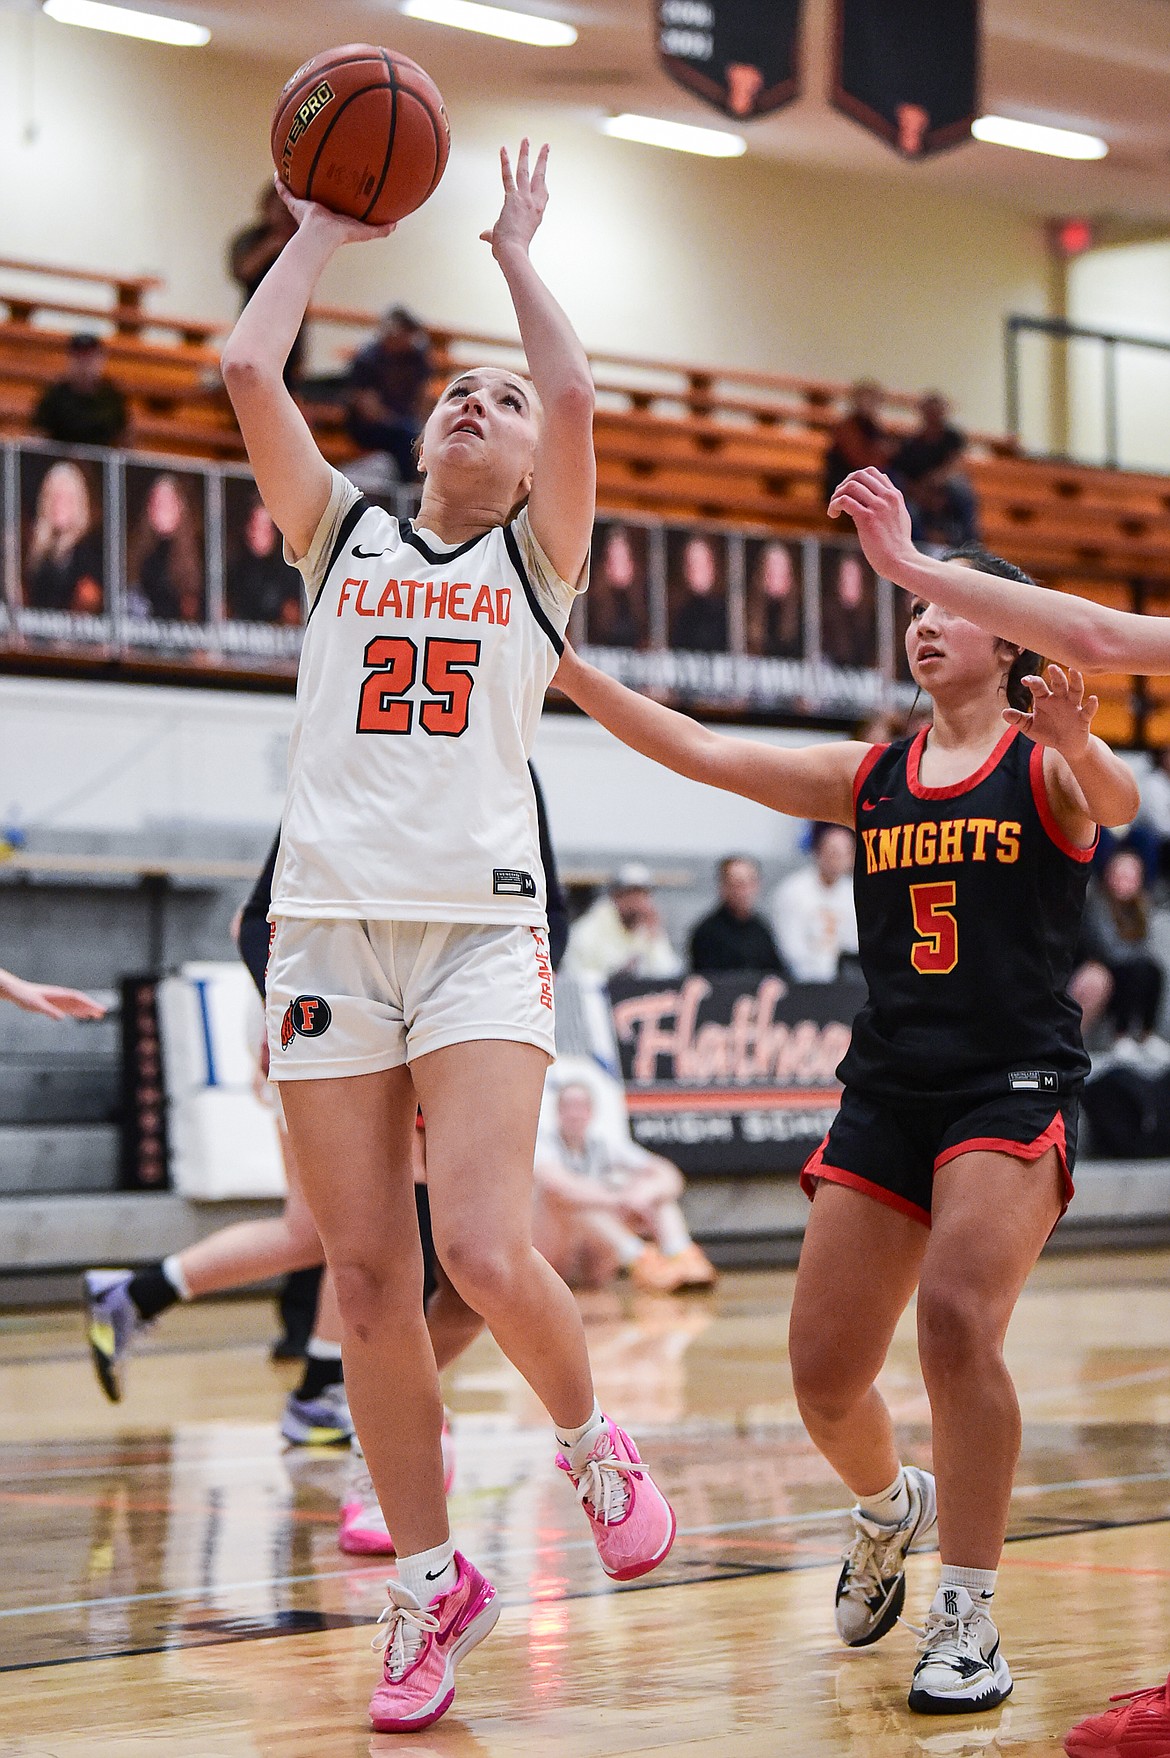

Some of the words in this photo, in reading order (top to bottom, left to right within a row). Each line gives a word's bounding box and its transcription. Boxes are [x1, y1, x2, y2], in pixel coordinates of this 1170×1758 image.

[298, 83, 333, 125] PRO
[337, 577, 512, 627] FLATHEAD
[356, 635, 482, 738] 25
[861, 818, 1023, 875] KNIGHTS
[908, 880, 959, 976] 5
[299, 1000, 319, 1031] F
[1044, 1076, 1054, 1087] M
